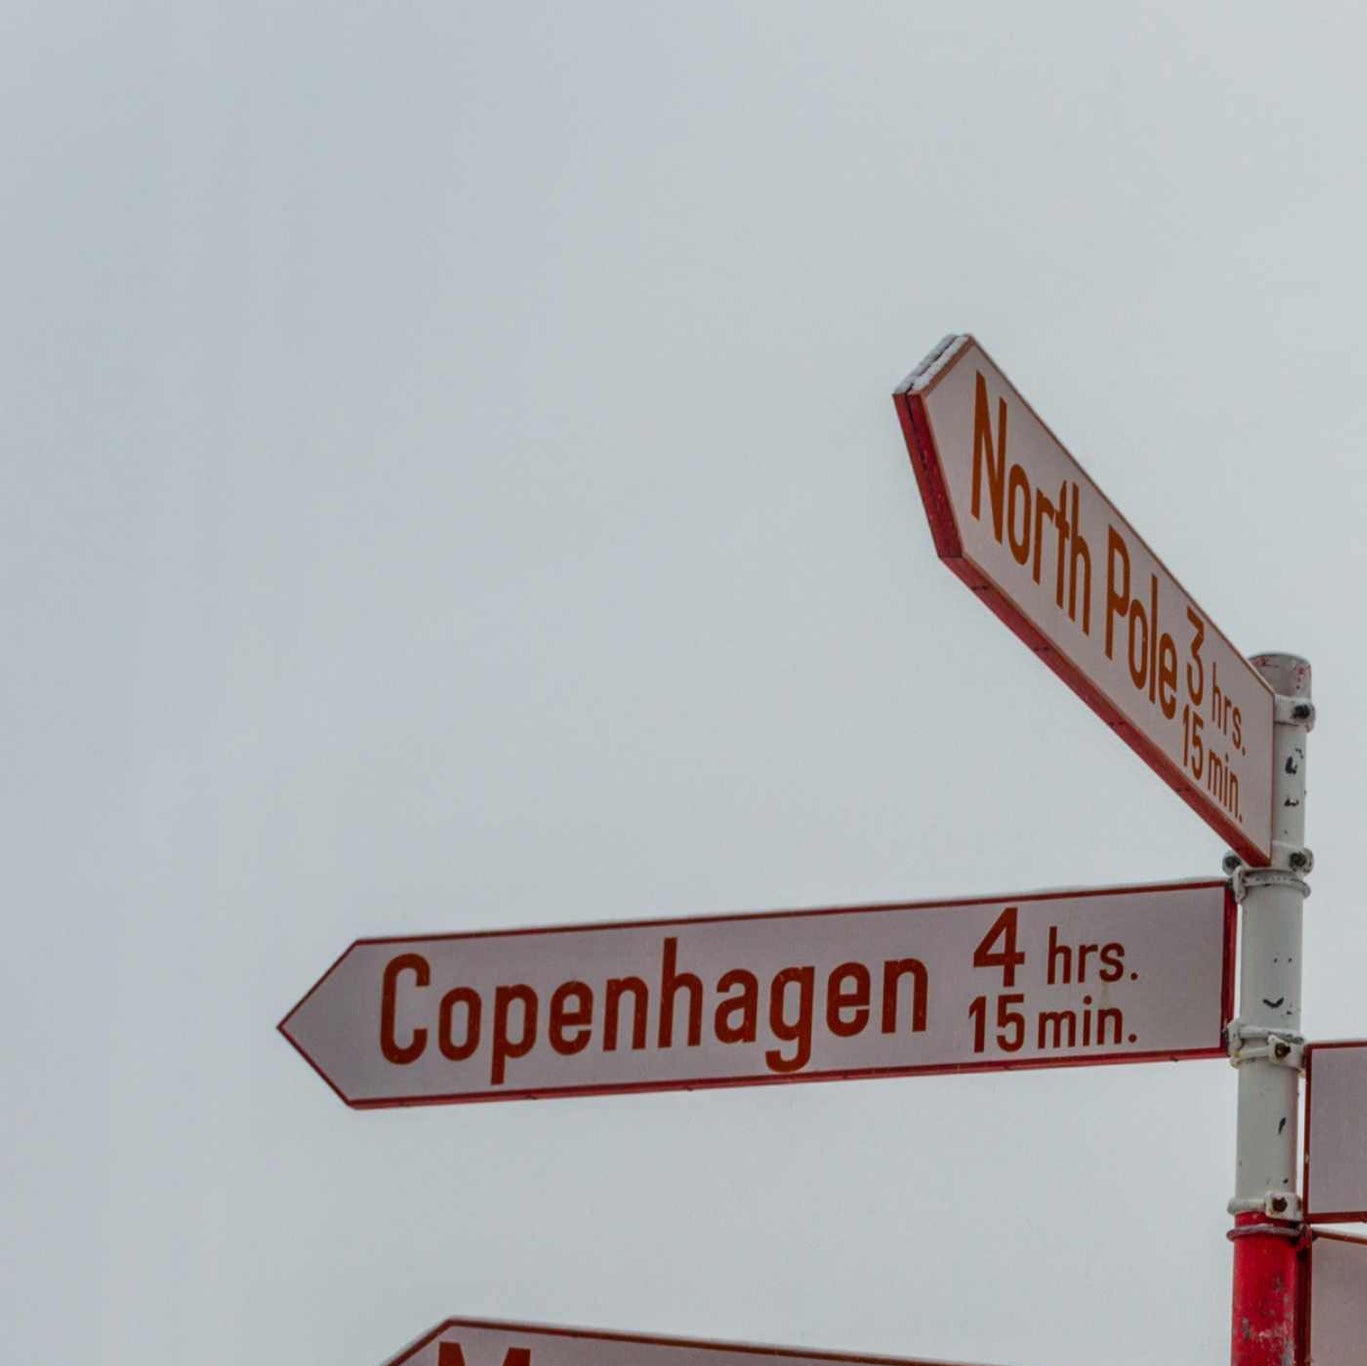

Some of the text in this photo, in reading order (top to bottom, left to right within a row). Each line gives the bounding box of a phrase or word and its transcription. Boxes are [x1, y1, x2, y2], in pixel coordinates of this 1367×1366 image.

[971, 371, 1246, 756] North Pole 3 hrs.
[1183, 704, 1243, 823] 15 min.
[380, 907, 1138, 1085] Copenhagen 4 hrs.
[969, 994, 1137, 1053] 15 min.
